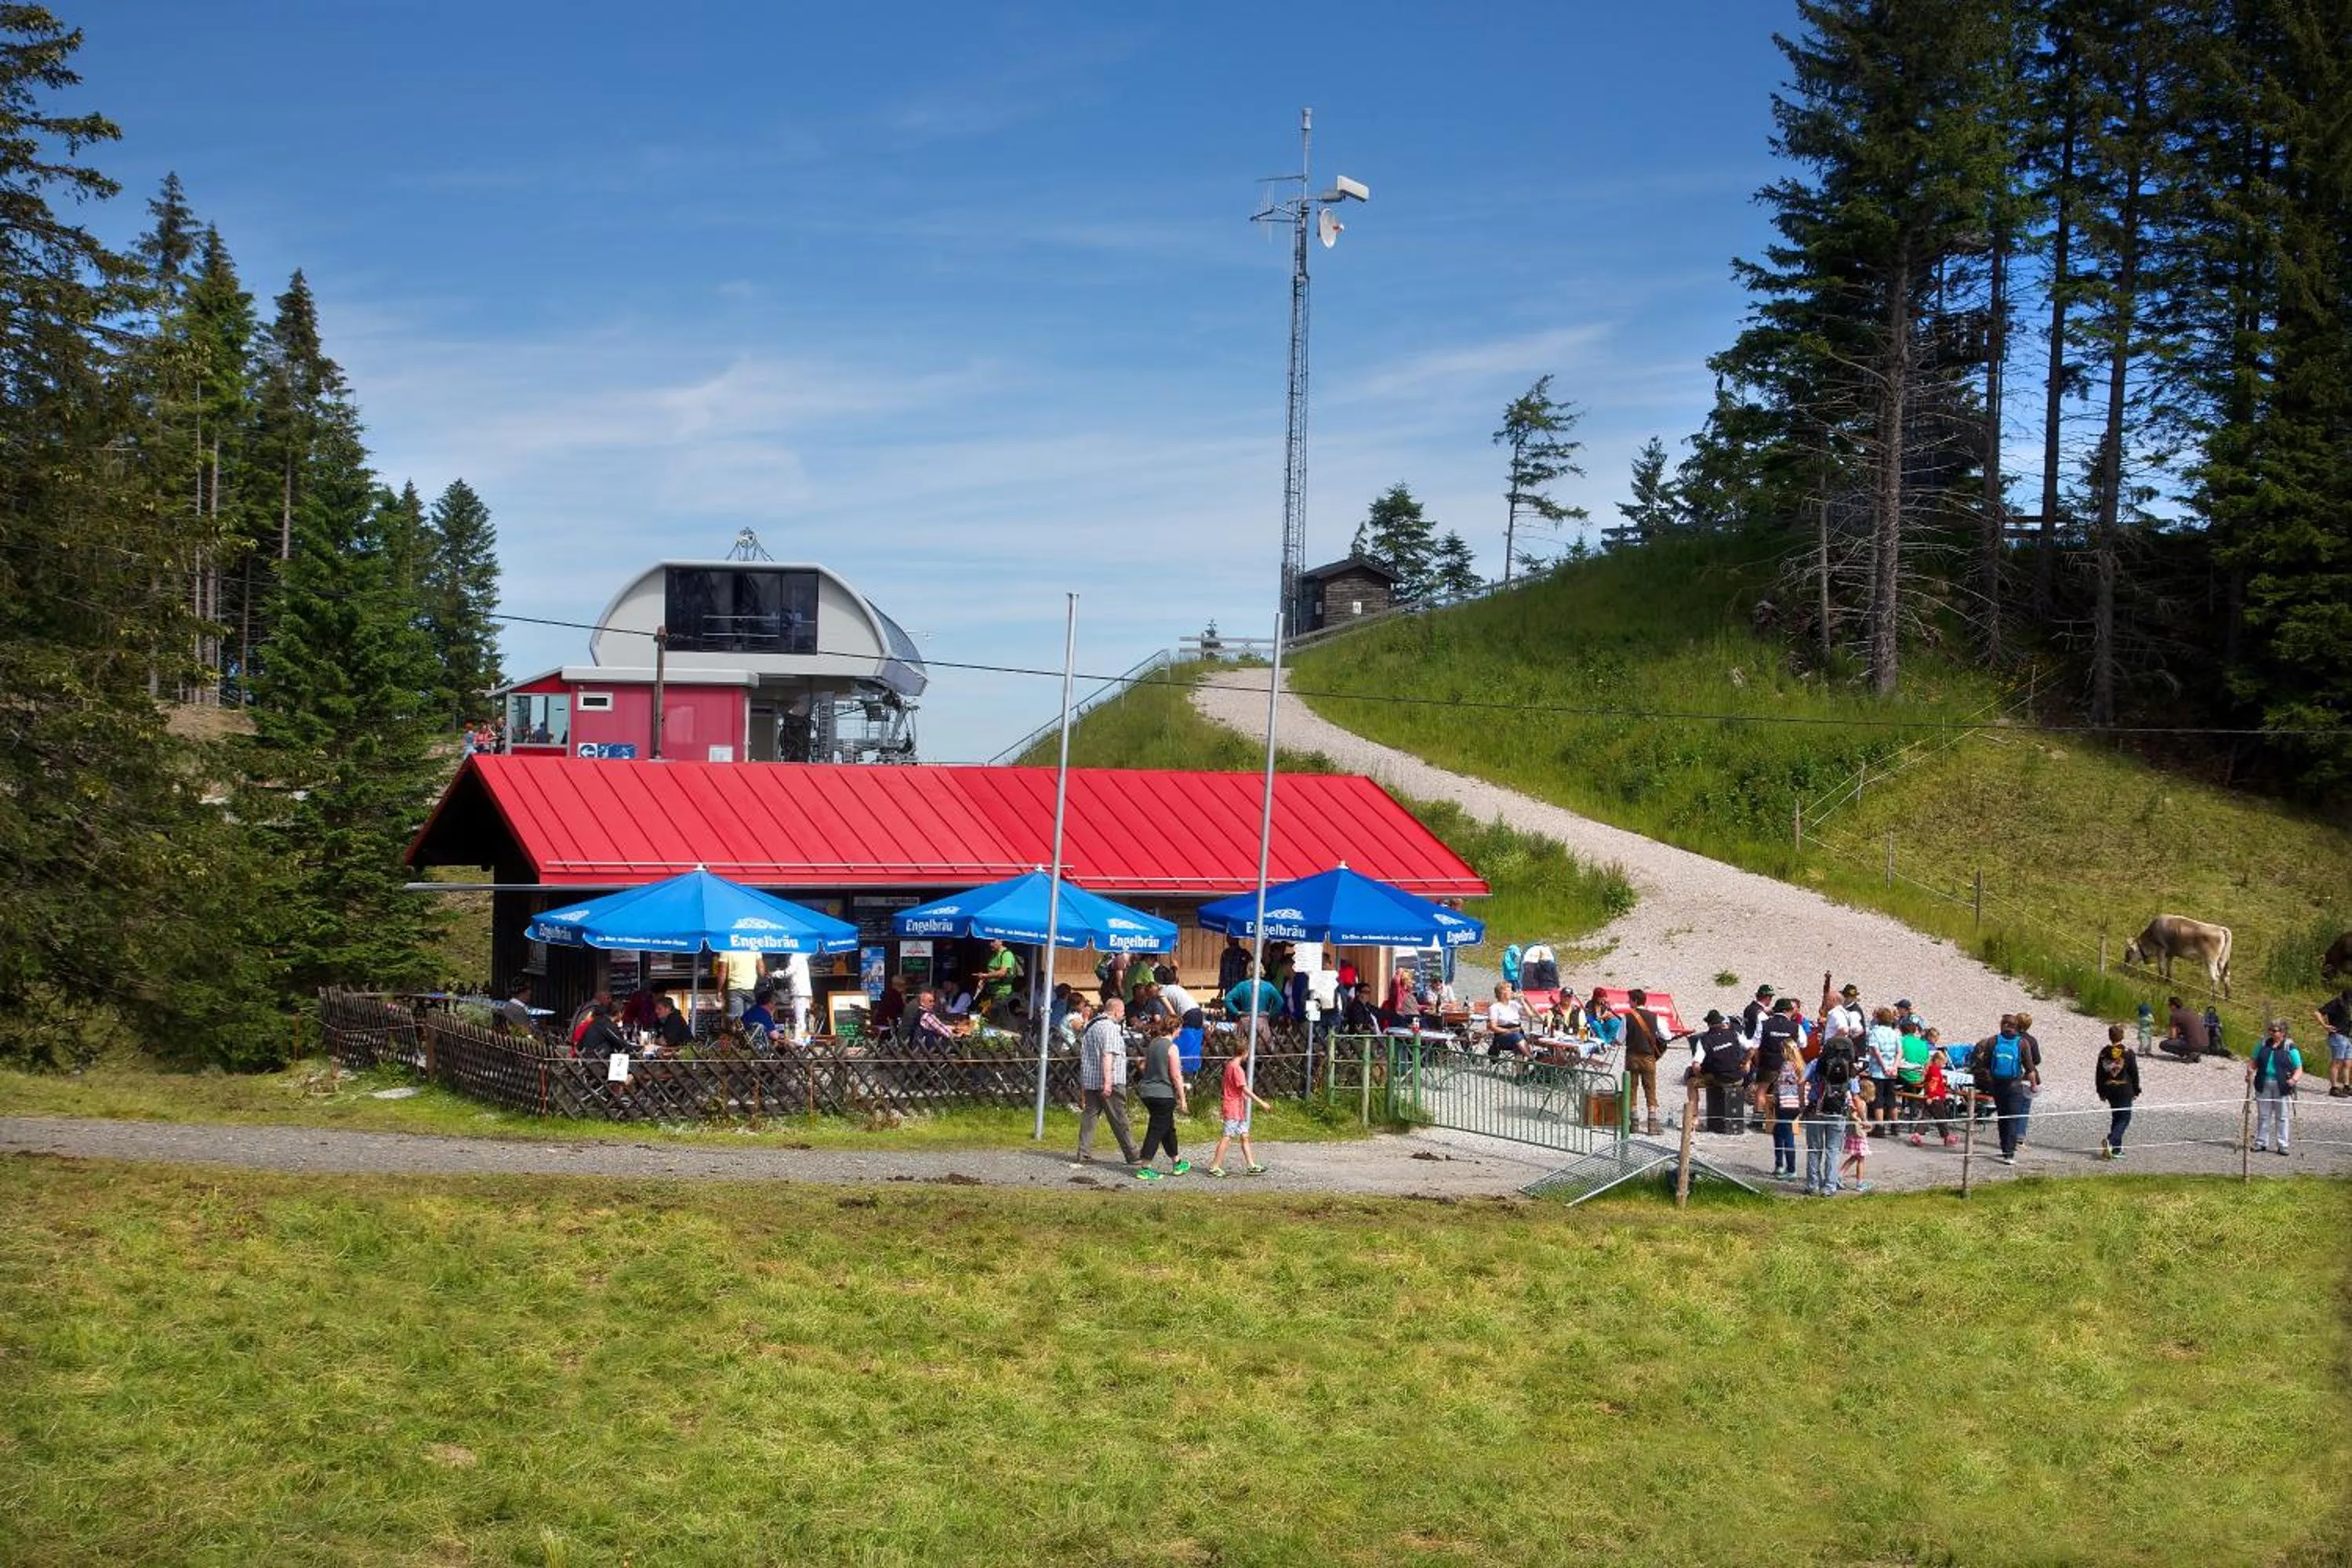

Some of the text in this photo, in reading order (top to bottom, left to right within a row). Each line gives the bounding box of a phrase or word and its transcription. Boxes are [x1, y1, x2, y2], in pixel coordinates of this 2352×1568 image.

[906, 918, 953, 935] Engelbräu
[1246, 922, 1306, 938] Egelbräu
[731, 934, 799, 951] Engelbräu
[1109, 934, 1160, 952] Engelbräu
